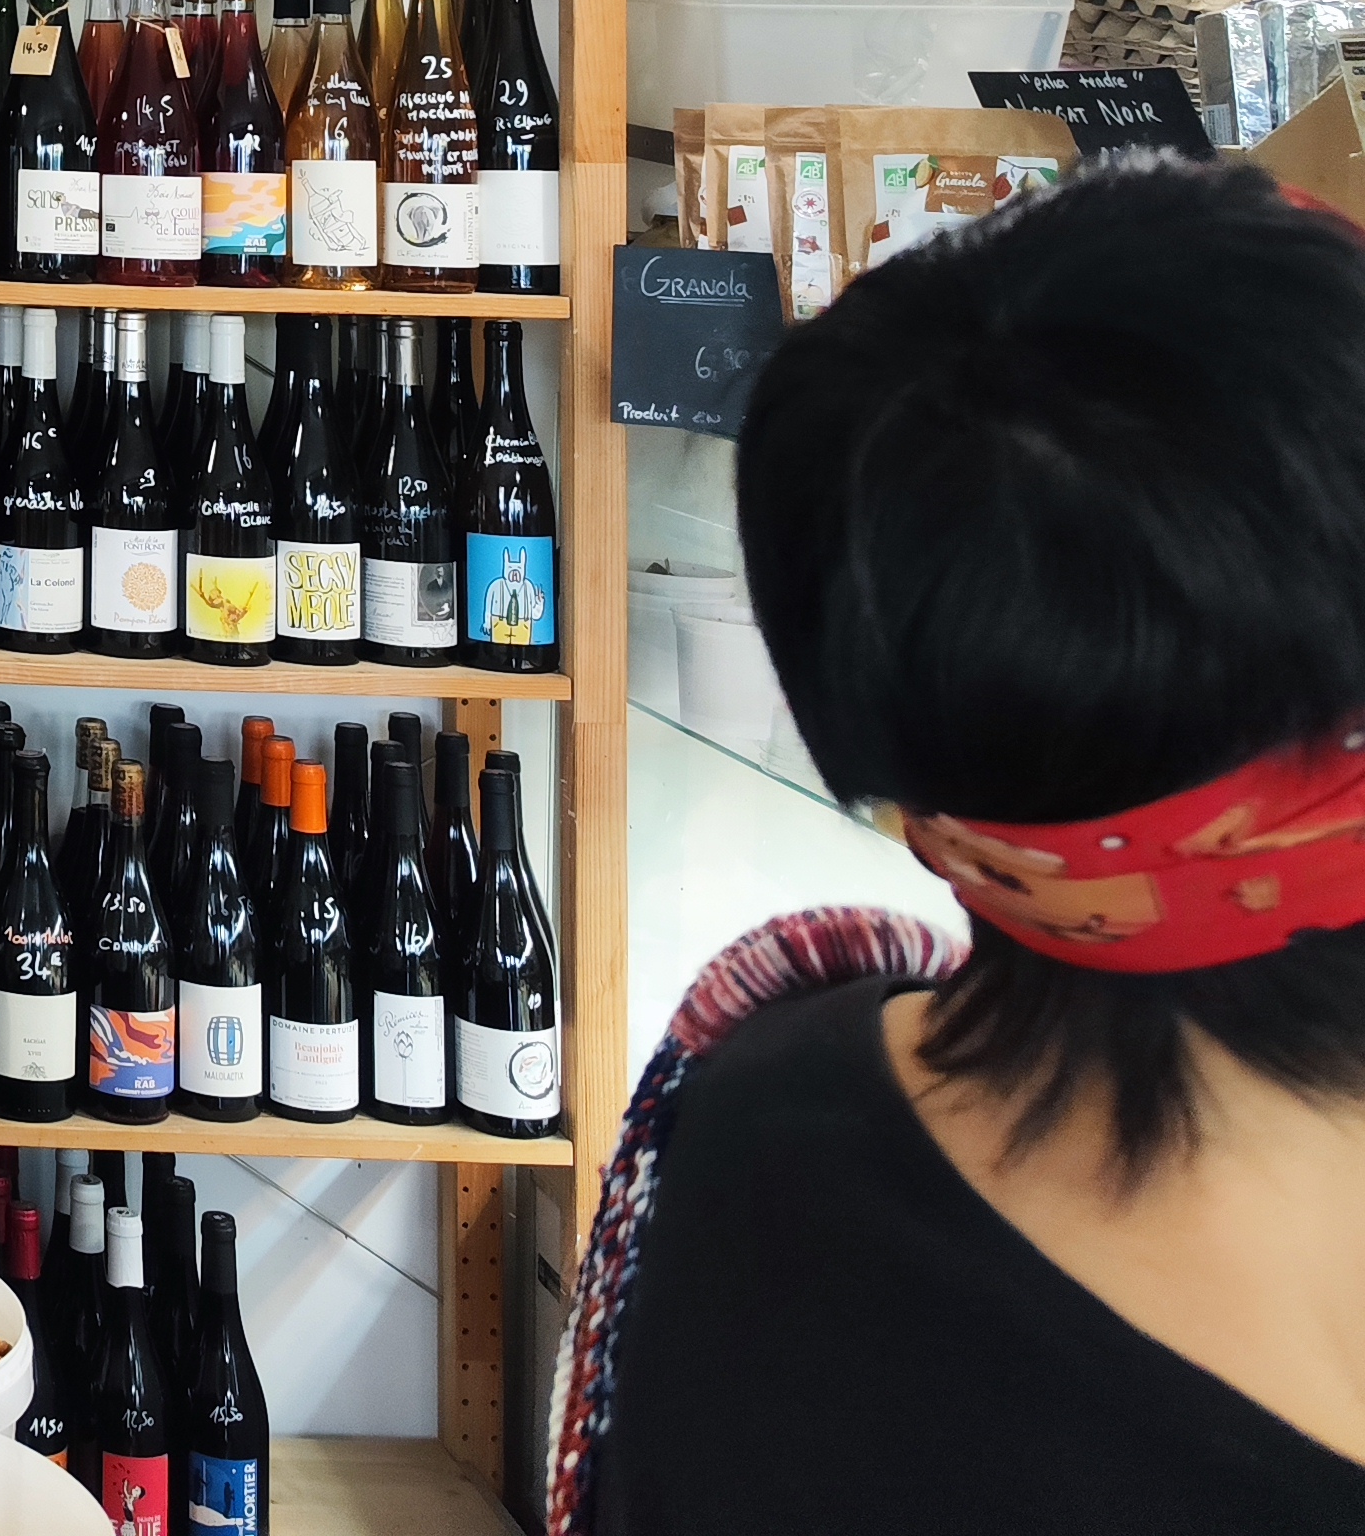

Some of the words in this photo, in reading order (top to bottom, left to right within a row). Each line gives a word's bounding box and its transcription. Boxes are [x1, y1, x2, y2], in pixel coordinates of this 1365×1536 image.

[421, 55, 453, 80] 25
[498, 79, 529, 107] 29
[935, 170, 988, 188] Granola
[156, 224, 169, 236] de
[245, 238, 267, 247] RAB
[617, 401, 680, 423] Produit
[284, 550, 357, 590] SECSY
[287, 587, 354, 630] MBOLE
[294, 1041, 344, 1055] Beaujolais
[296, 1052, 342, 1065] Lantignié
[134, 1079, 156, 1088] RAB
[204, 1070, 244, 1080] MALOLACTIX
[243, 1462, 256, 1531] MORTIER
